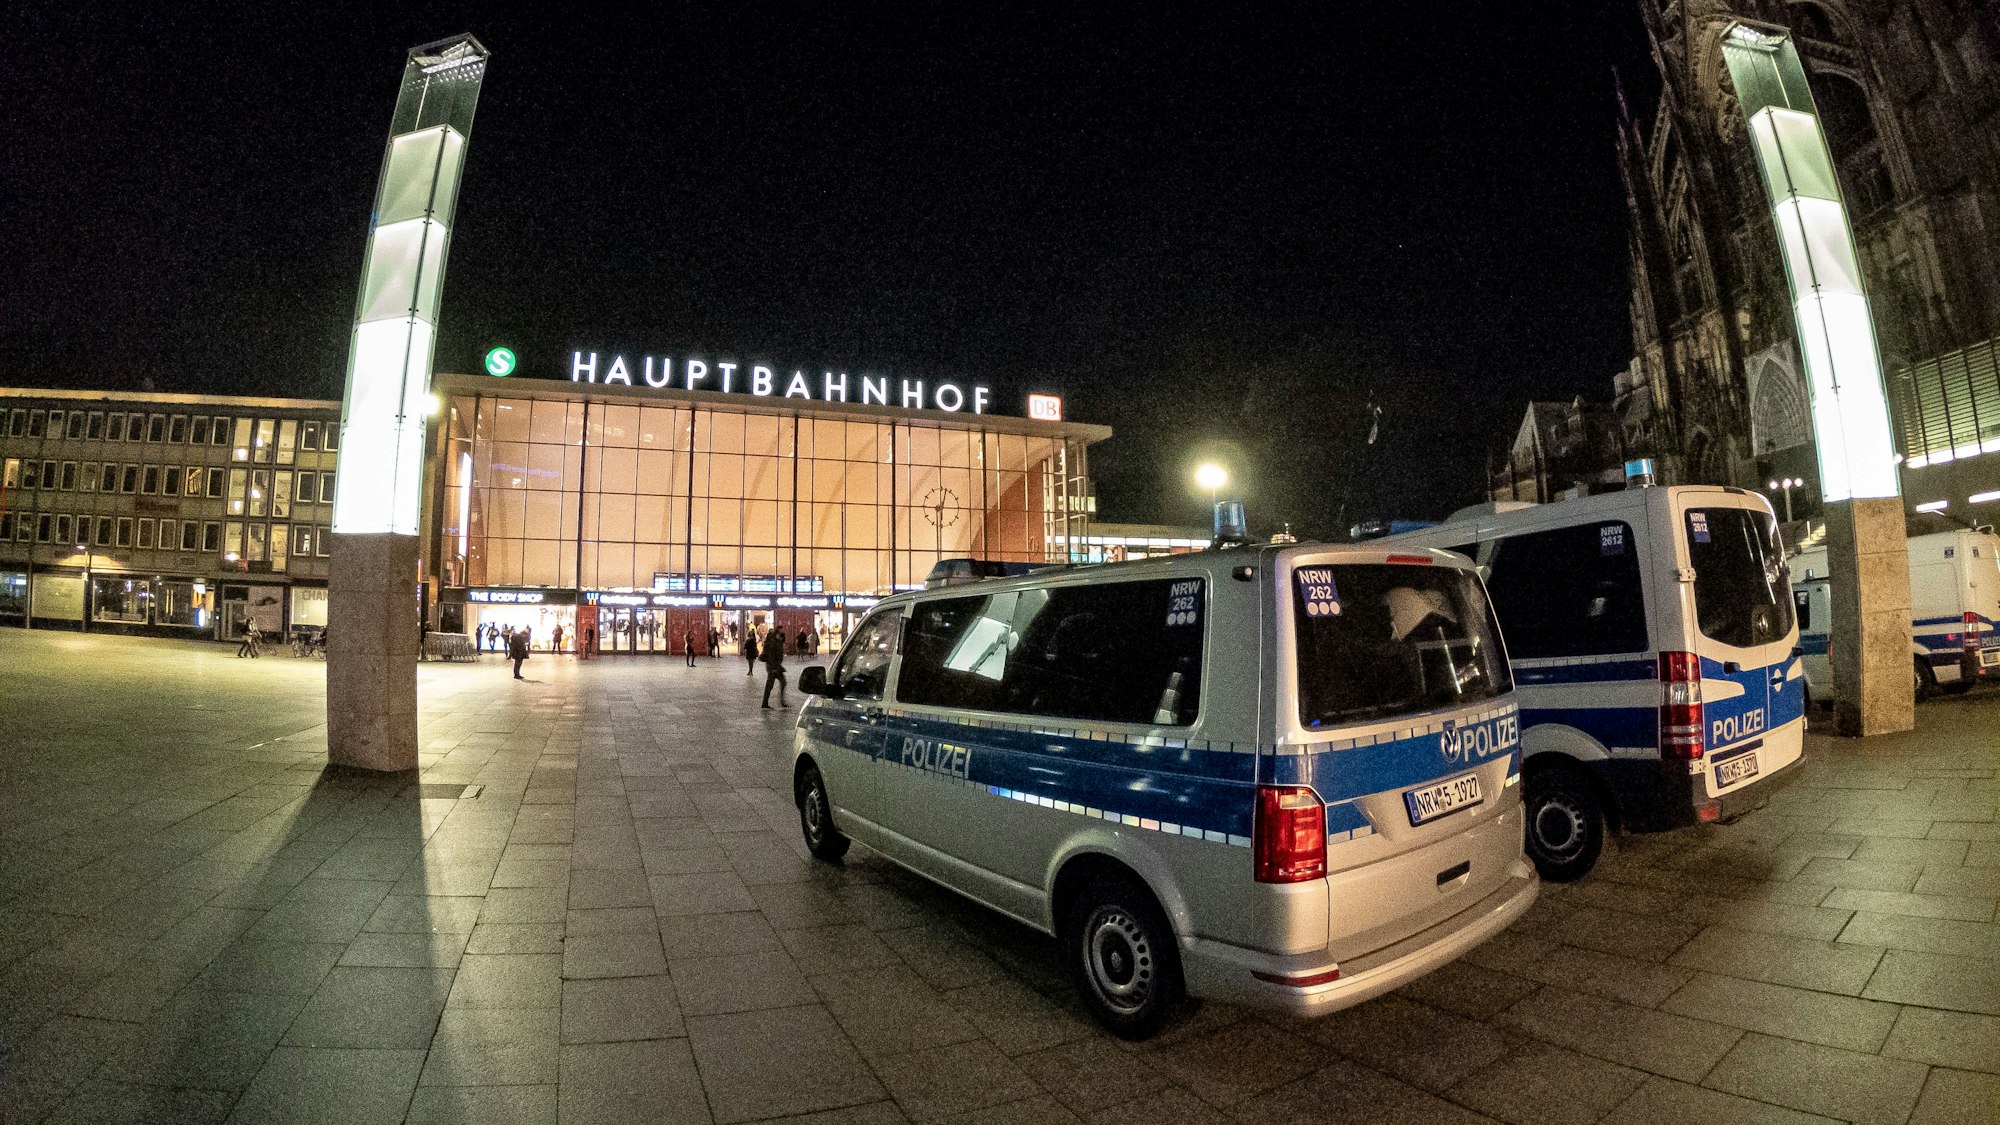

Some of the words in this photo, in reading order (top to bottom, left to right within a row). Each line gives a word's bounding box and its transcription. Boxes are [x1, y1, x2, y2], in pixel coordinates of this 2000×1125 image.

[489, 349, 512, 375] S
[571, 351, 989, 415] HAUPTBAHNHOF
[1034, 399, 1057, 417] DB
[1689, 513, 1705, 522] NRW
[1601, 525, 1623, 537] NRW
[1693, 523, 1708, 532] 2612
[1602, 535, 1623, 546] 2612
[1299, 570, 1332, 584] NRW
[1171, 581, 1200, 597] NRW
[1308, 586, 1333, 600] 262
[470, 592, 489, 602] THE
[517, 592, 544, 603] SHOP
[1173, 597, 1194, 611] 262
[1712, 708, 1764, 744] POLIZEI
[1463, 716, 1519, 762] POLIZEI
[901, 737, 972, 780] POLIZEI
[1720, 763, 1735, 781] NRW
[1416, 788, 1440, 816] NRW
[1442, 777, 1478, 806] 5-1927
